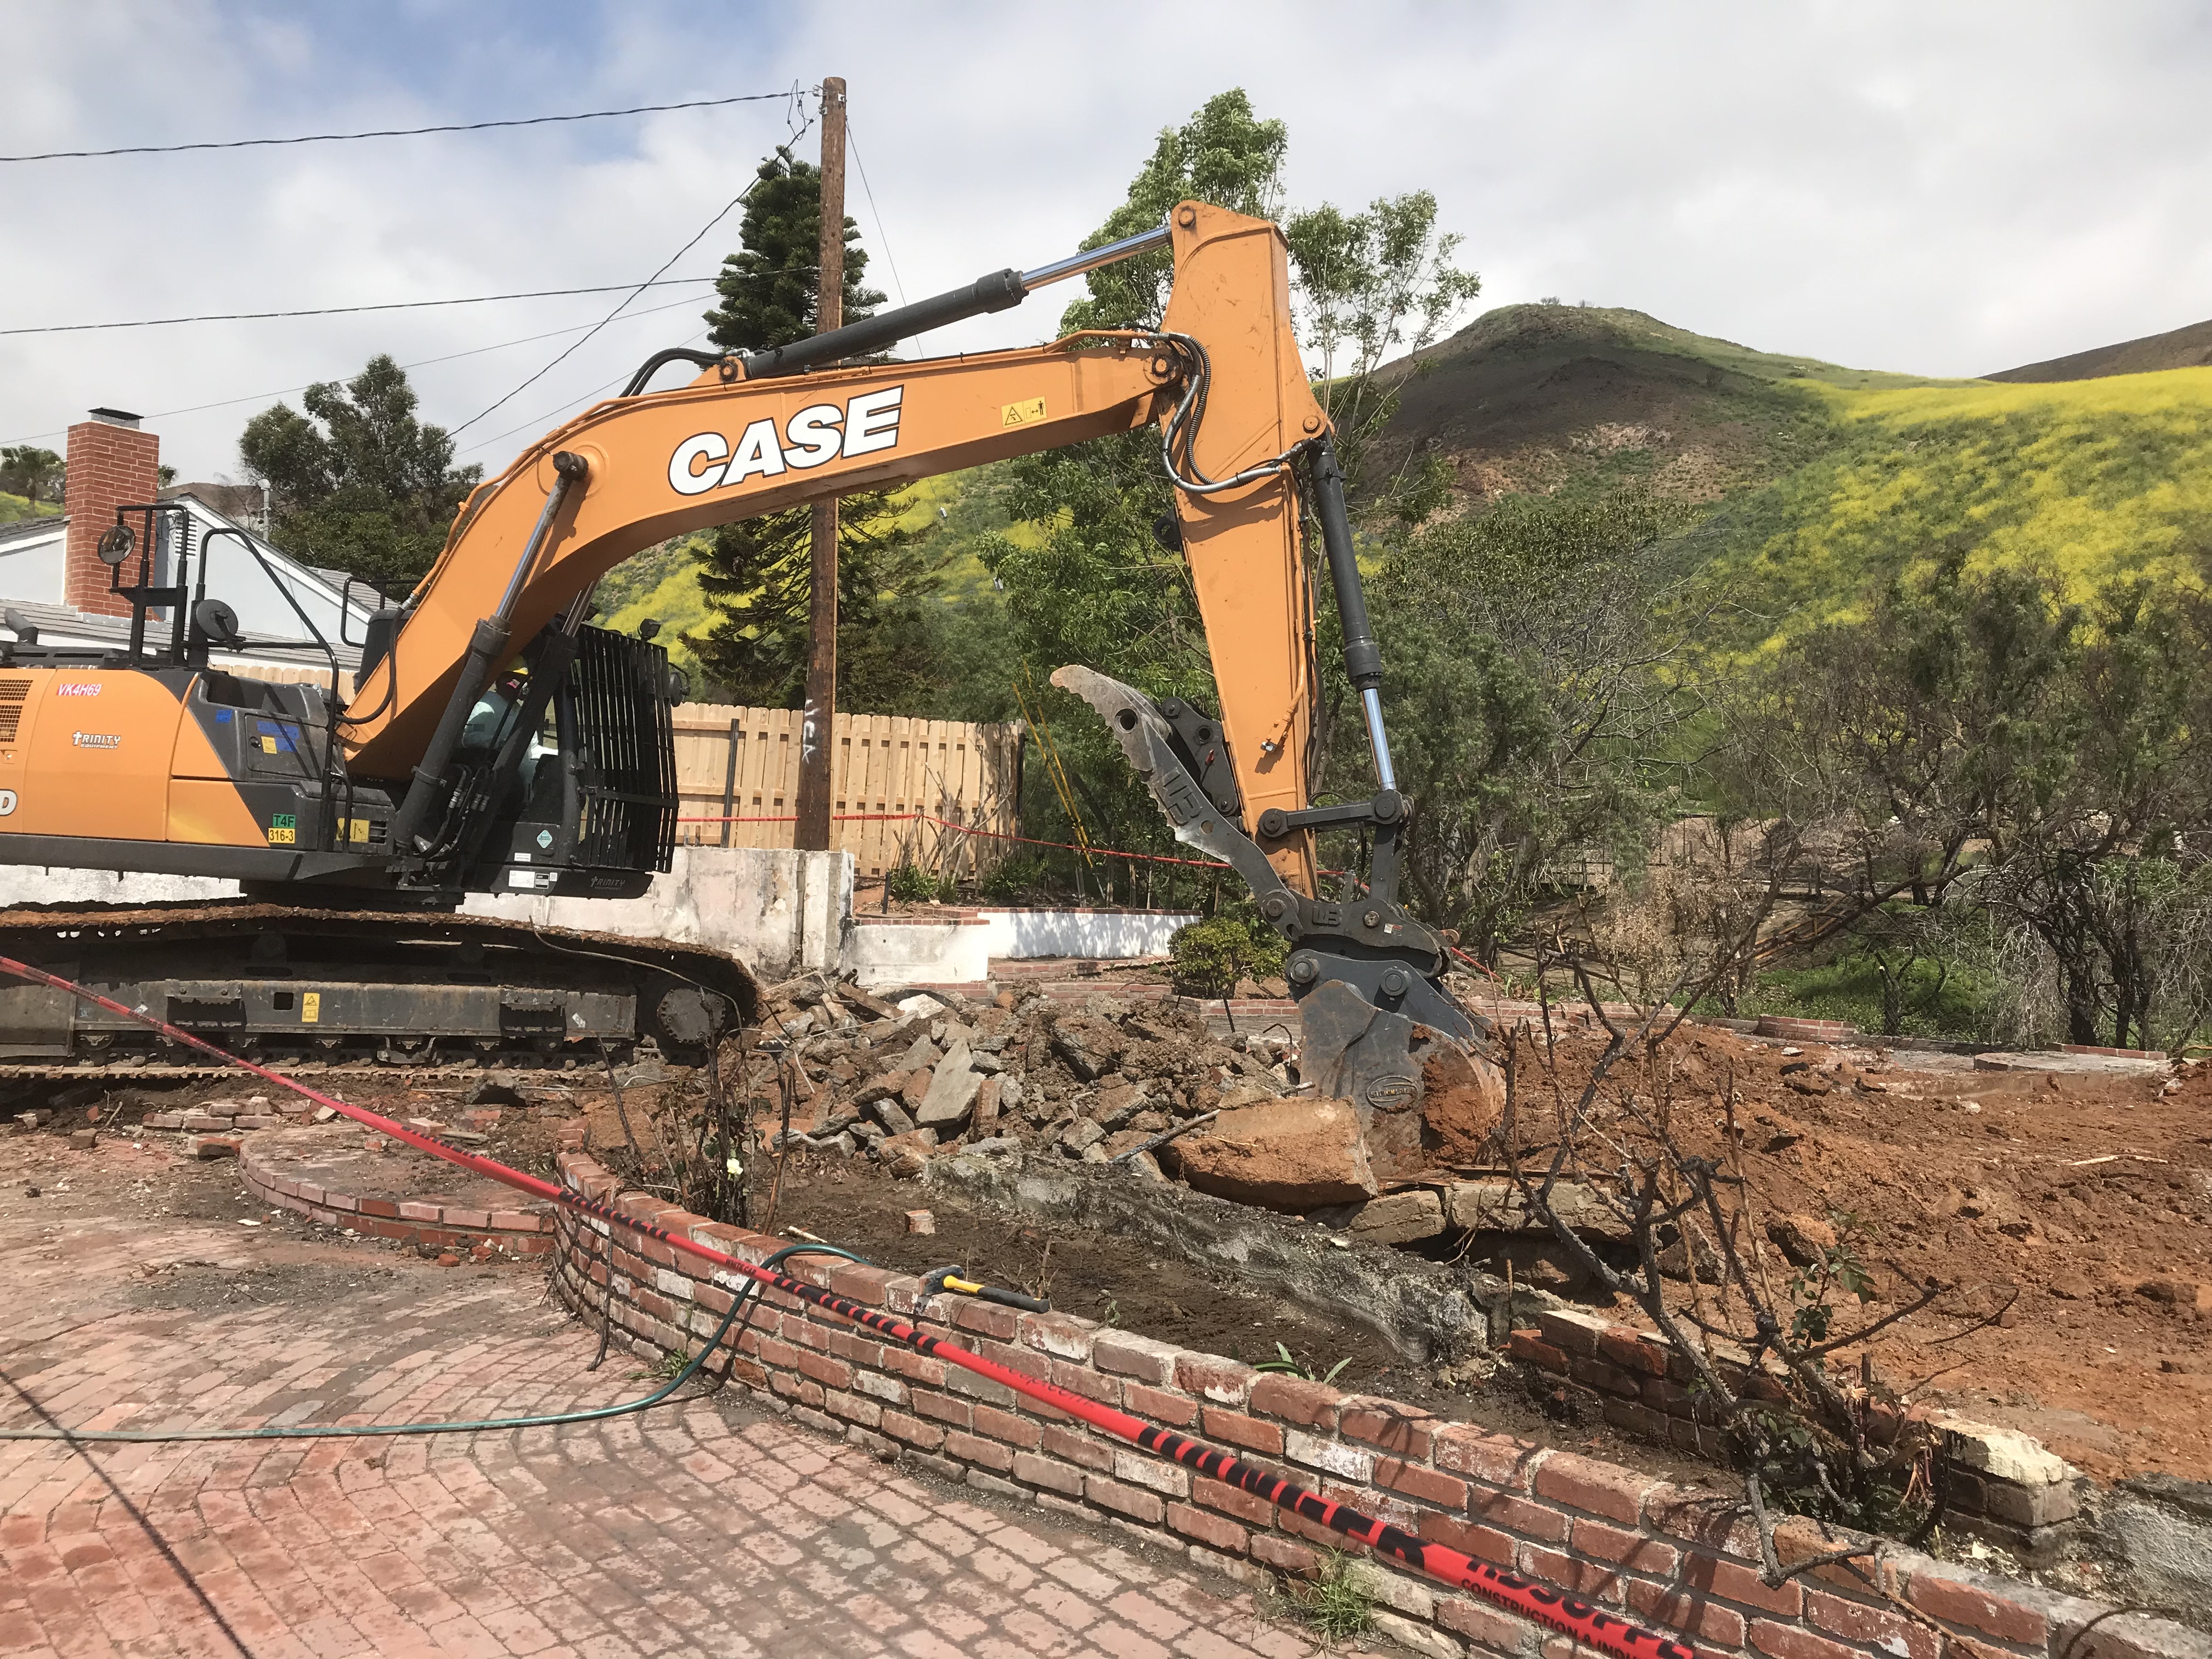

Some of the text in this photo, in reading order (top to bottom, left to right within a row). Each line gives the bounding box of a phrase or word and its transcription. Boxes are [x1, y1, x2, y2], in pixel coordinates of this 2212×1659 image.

[668, 385, 904, 495] CASE
[58, 684, 102, 696] VK4H69
[72, 730, 121, 746] TRINITY
[274, 815, 295, 827] T4F
[269, 830, 294, 842] 316-3
